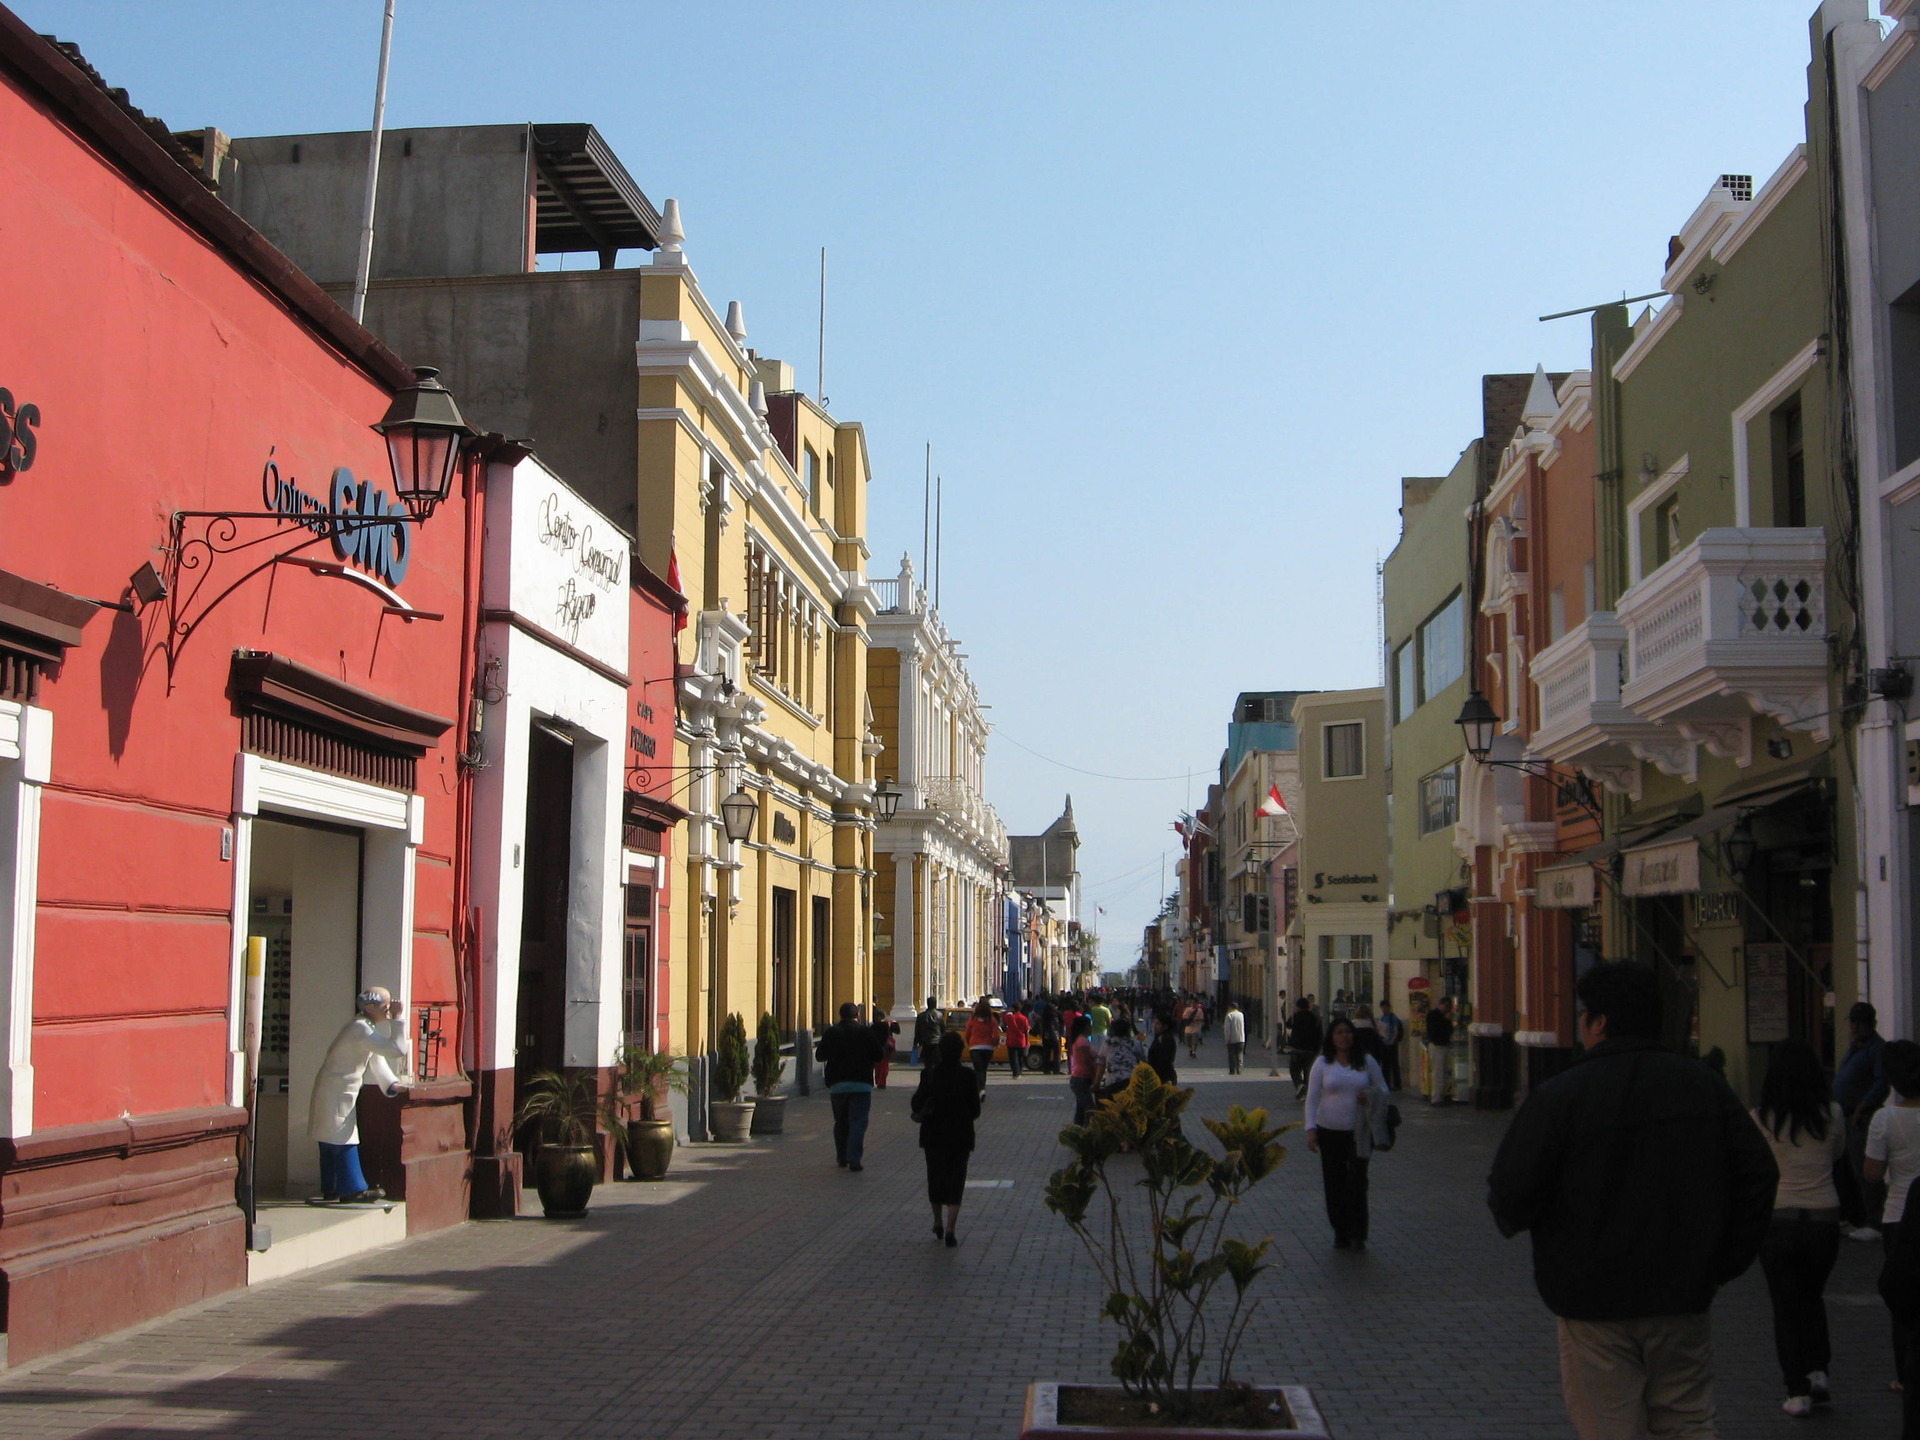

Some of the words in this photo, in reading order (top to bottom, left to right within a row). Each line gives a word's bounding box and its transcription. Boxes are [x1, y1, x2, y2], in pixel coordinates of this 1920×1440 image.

[263, 446, 333, 537] Ópticas
[331, 466, 411, 588] GMO
[1327, 874, 1379, 885] Scotiabank
